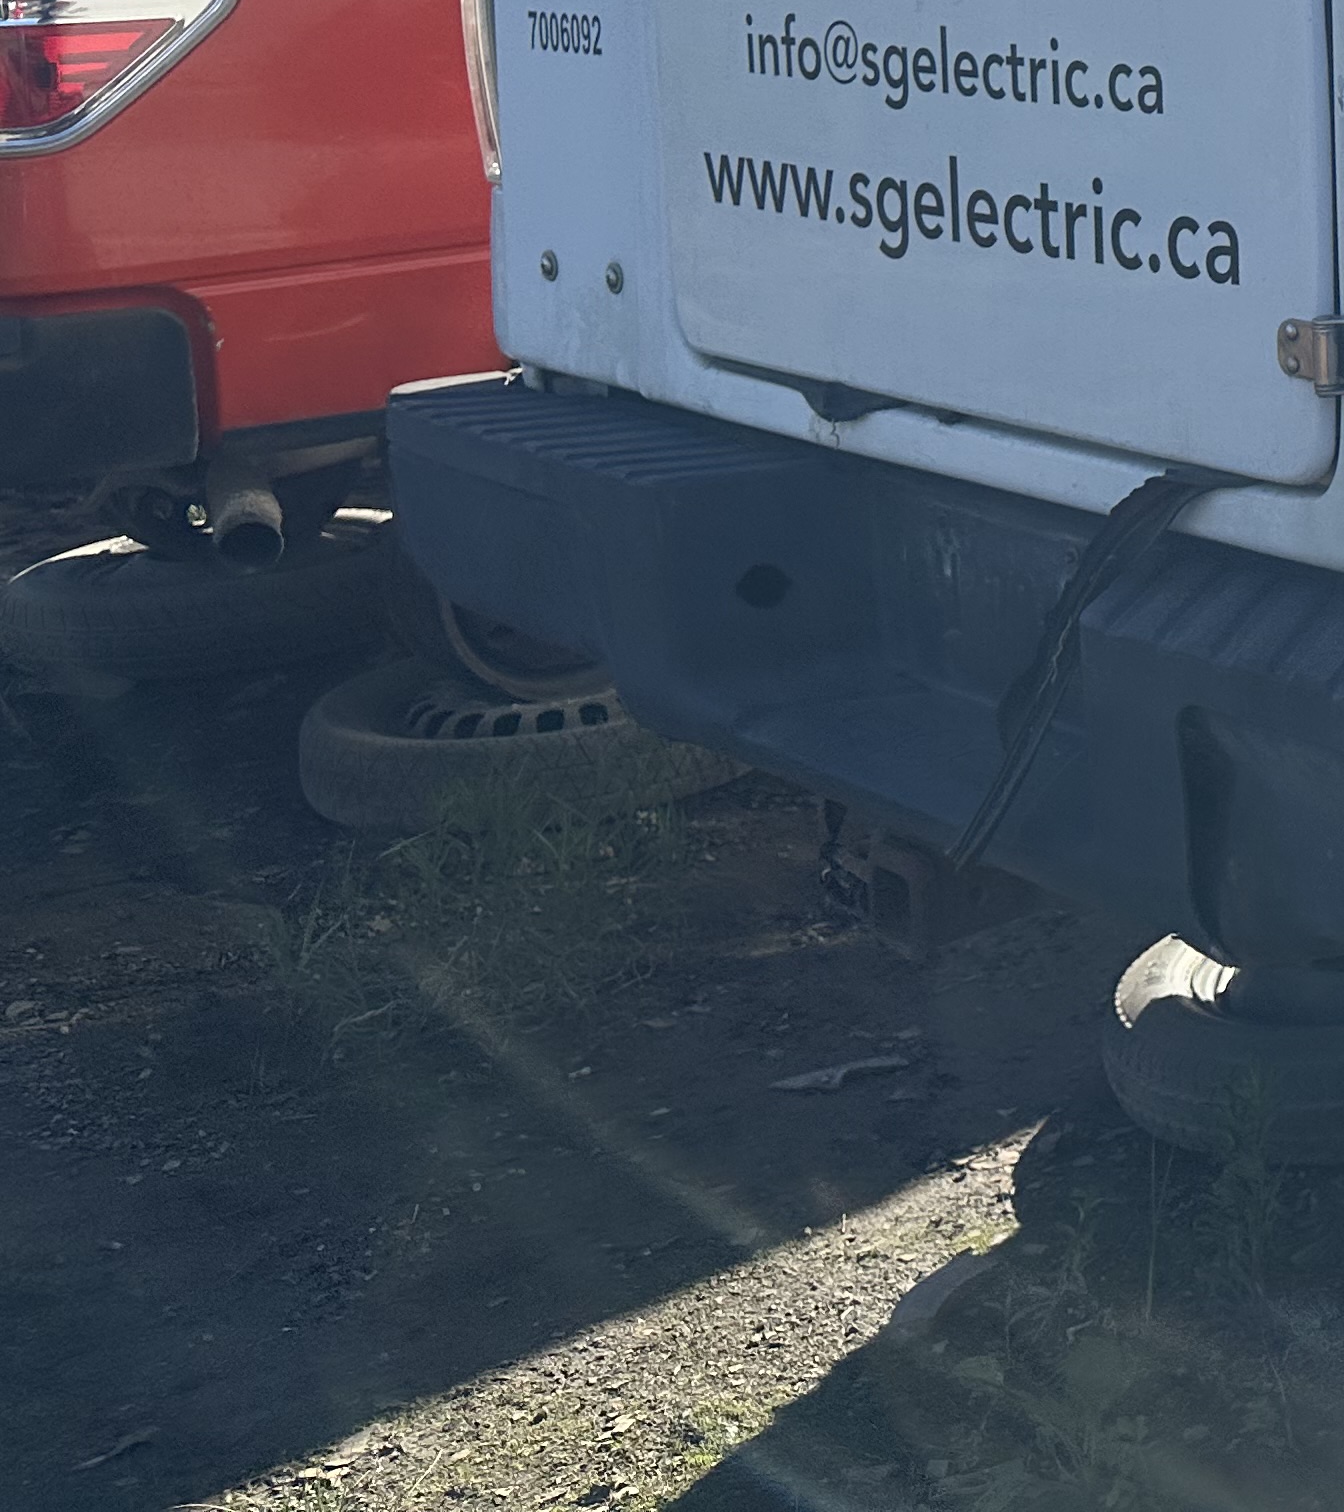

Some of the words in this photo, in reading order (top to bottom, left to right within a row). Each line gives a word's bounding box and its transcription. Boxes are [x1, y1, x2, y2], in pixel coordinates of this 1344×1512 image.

[527, 10, 603, 57] 7006092
[745, 13, 1166, 116] info@sgelectric.ca
[703, 150, 1241, 287] www.sgelectric.ca
